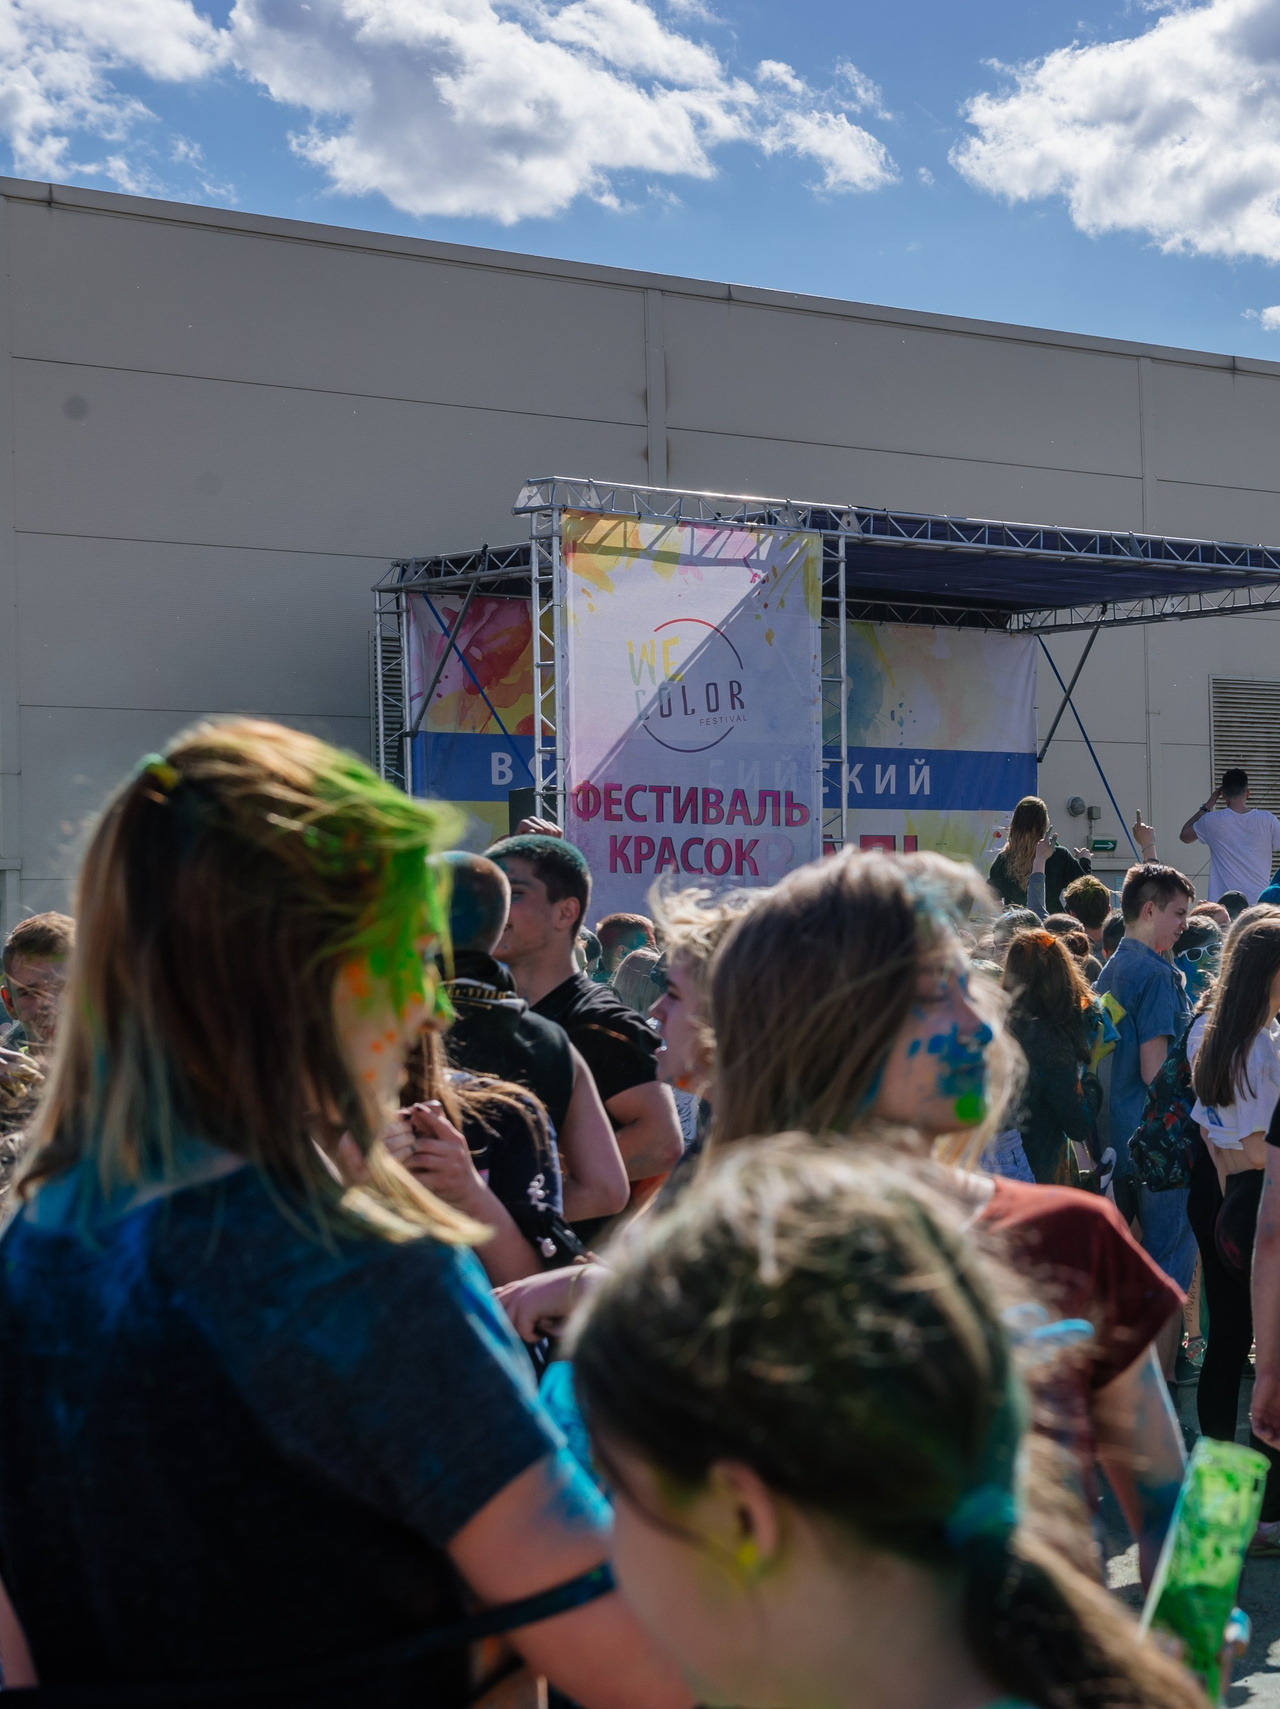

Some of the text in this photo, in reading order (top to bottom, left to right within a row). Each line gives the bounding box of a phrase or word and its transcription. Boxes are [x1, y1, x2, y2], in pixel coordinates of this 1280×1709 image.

[626, 635, 683, 687] WE
[634, 680, 745, 721] COLOR
[699, 715, 748, 727] FESTIVAL
[571, 780, 811, 827] ФЕСТИВАЛЬ
[609, 835, 760, 876] КРАСОК
